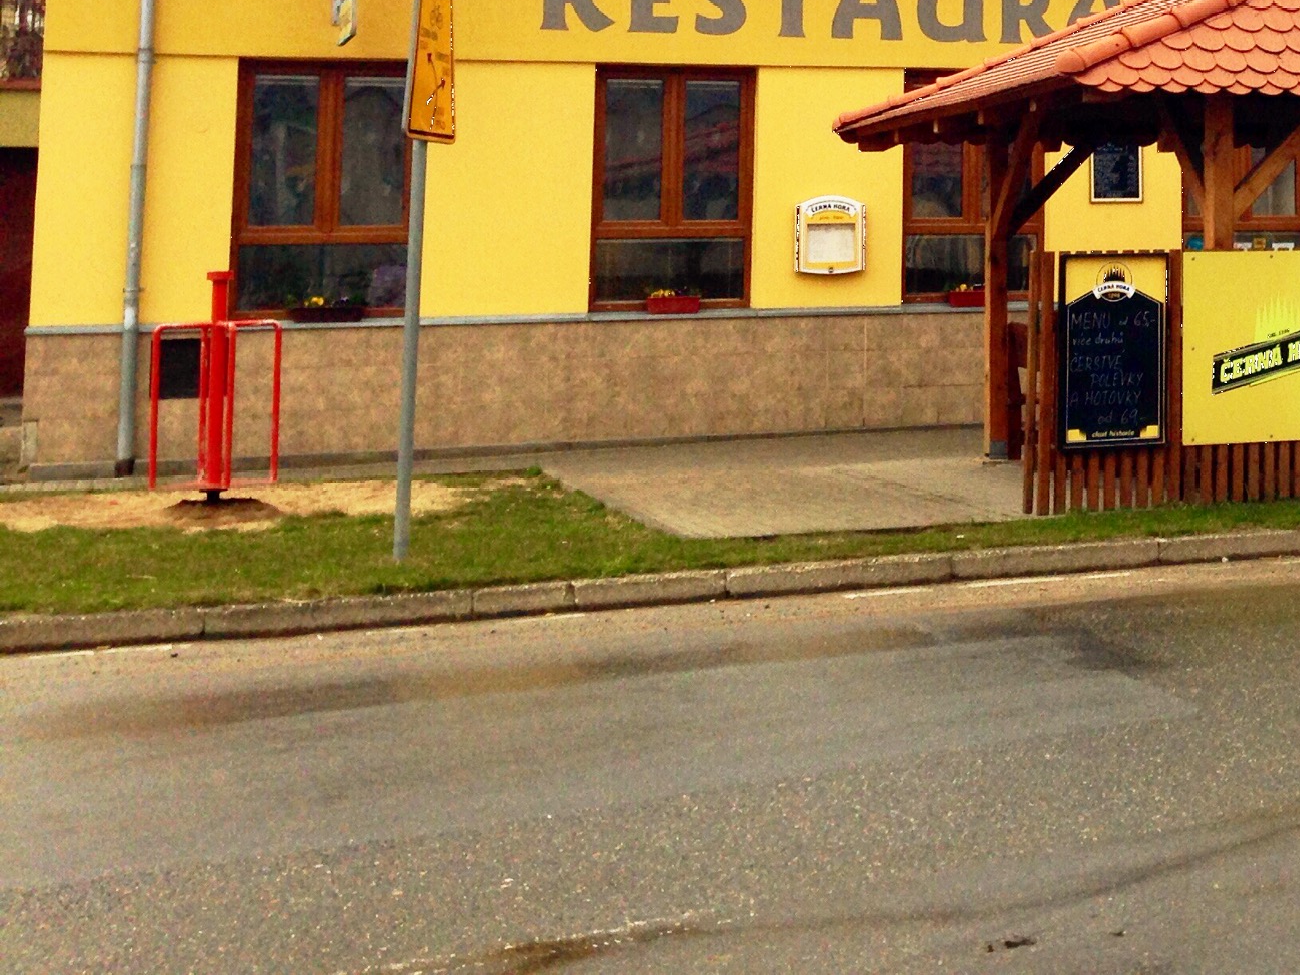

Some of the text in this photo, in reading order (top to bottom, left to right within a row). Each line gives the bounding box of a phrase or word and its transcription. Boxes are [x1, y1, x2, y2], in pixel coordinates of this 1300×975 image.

[1071, 311, 1111, 329] MENU
[1220, 344, 1283, 383] ČERNÁ
[1085, 390, 1142, 405] HOTOVKY
[1097, 409, 1113, 425] od
